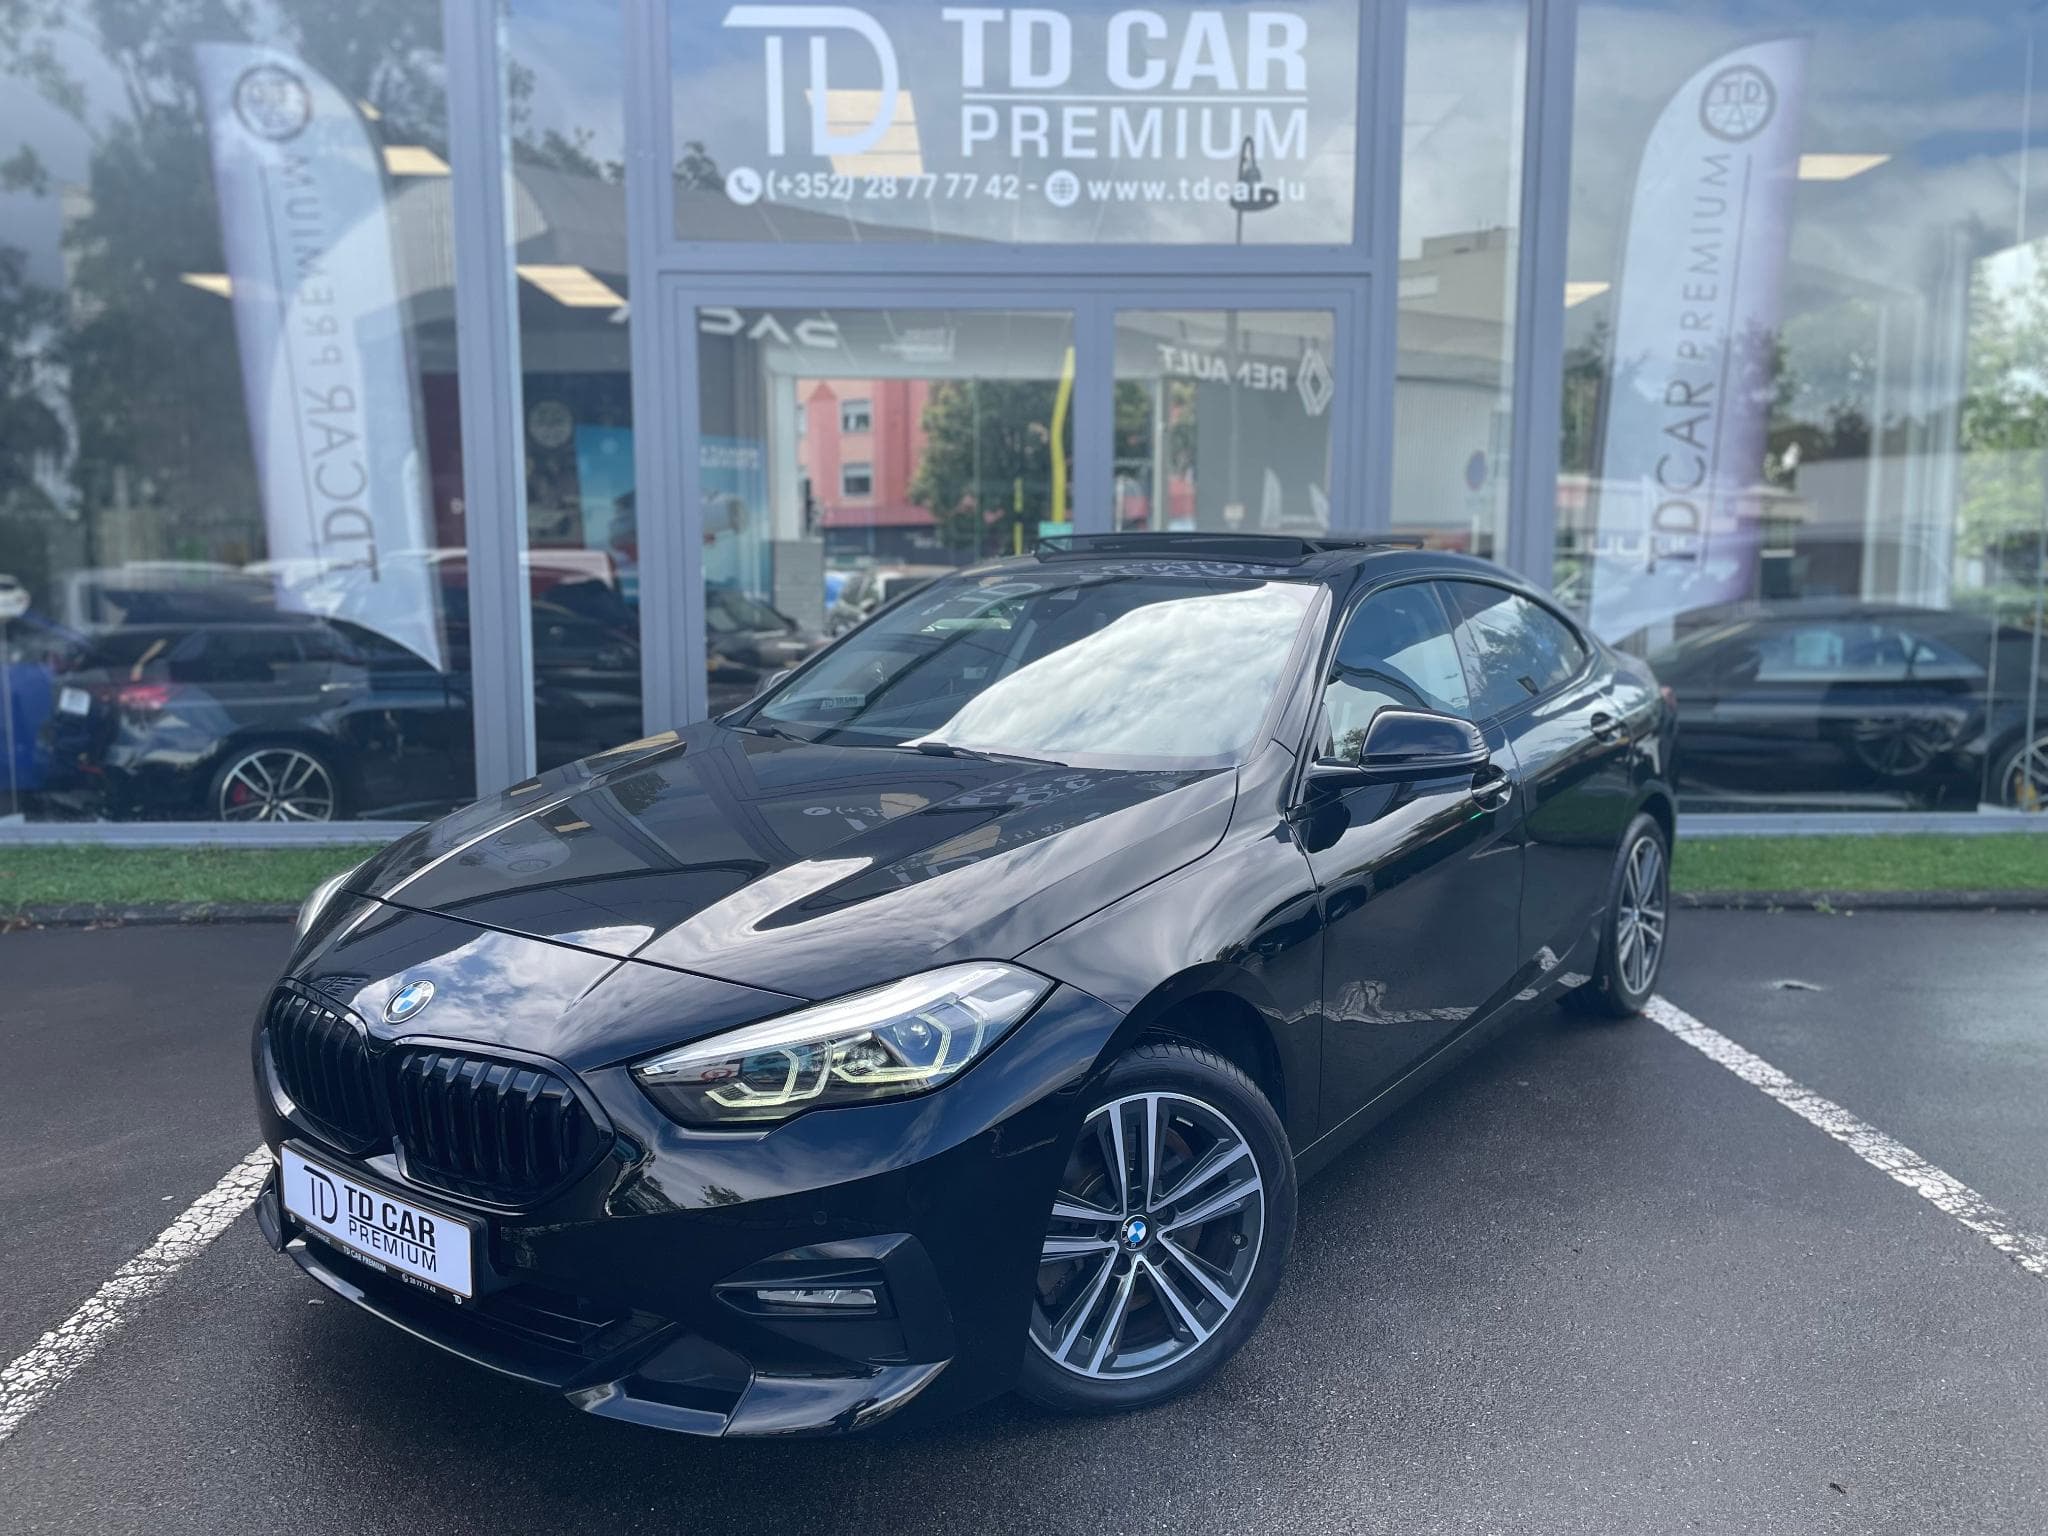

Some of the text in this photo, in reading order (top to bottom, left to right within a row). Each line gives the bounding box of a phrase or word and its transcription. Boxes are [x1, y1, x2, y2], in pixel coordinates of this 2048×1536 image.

[942, 8, 1309, 91] TD CAR
[961, 105, 1309, 160] PREMIUM
[766, 170, 855, 200] (+352)
[864, 174, 899, 200] 28
[906, 174, 938, 200] 77
[945, 174, 979, 200] 77
[984, 175, 1020, 200] 42
[1087, 177, 1306, 202] www.tdcar.lu
[1646, 152, 1732, 576] TDCAR PREMIUM
[344, 1184, 374, 1222] TD
[382, 1202, 436, 1249] CAR
[349, 1218, 437, 1273] PREMIUM
